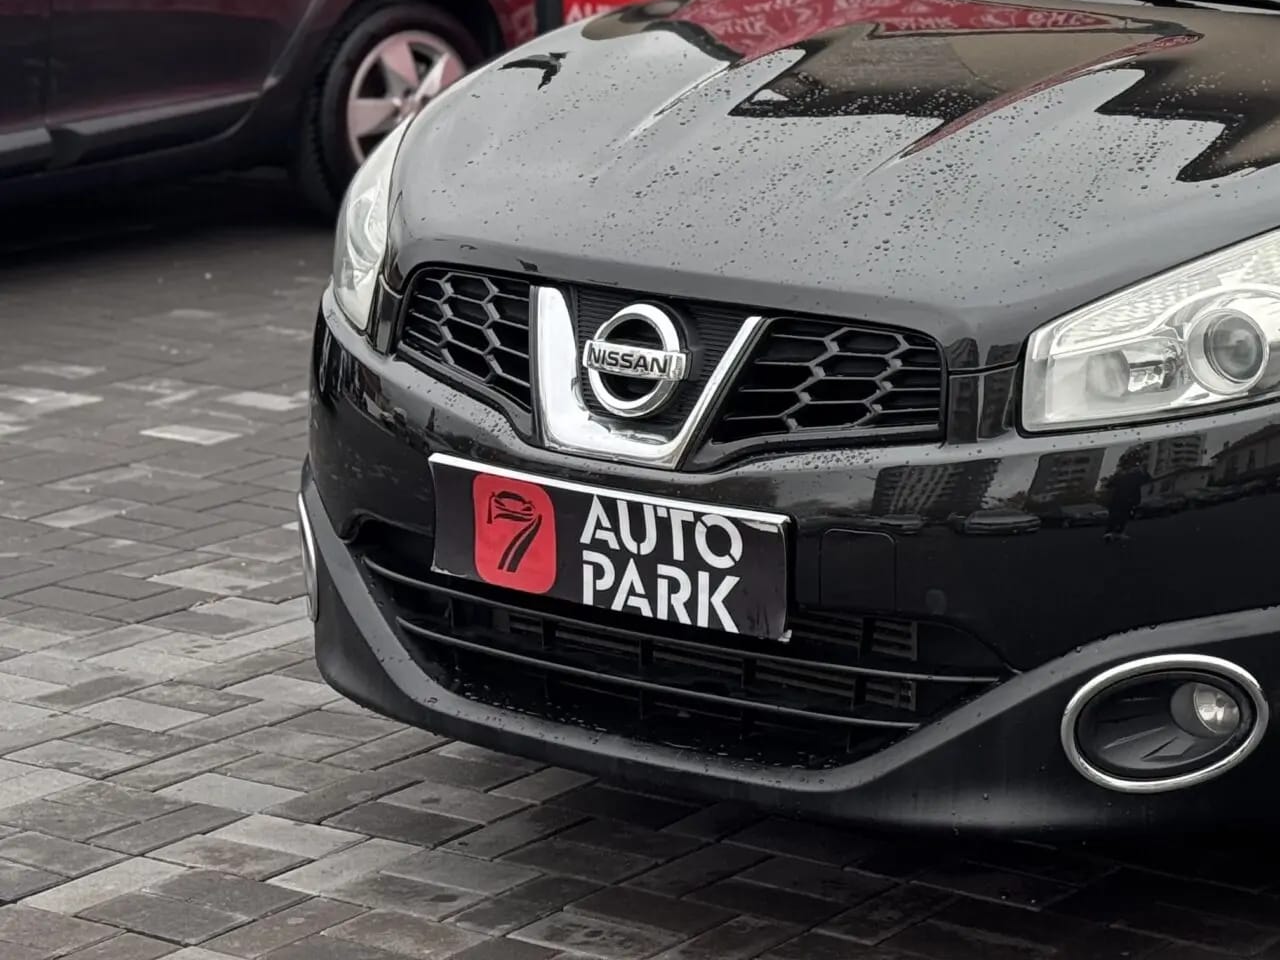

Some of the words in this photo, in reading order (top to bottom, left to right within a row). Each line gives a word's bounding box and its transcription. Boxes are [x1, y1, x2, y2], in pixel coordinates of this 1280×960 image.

[588, 348, 671, 374] NISSAN
[580, 494, 743, 569] AUTO
[582, 557, 740, 634] PARK
